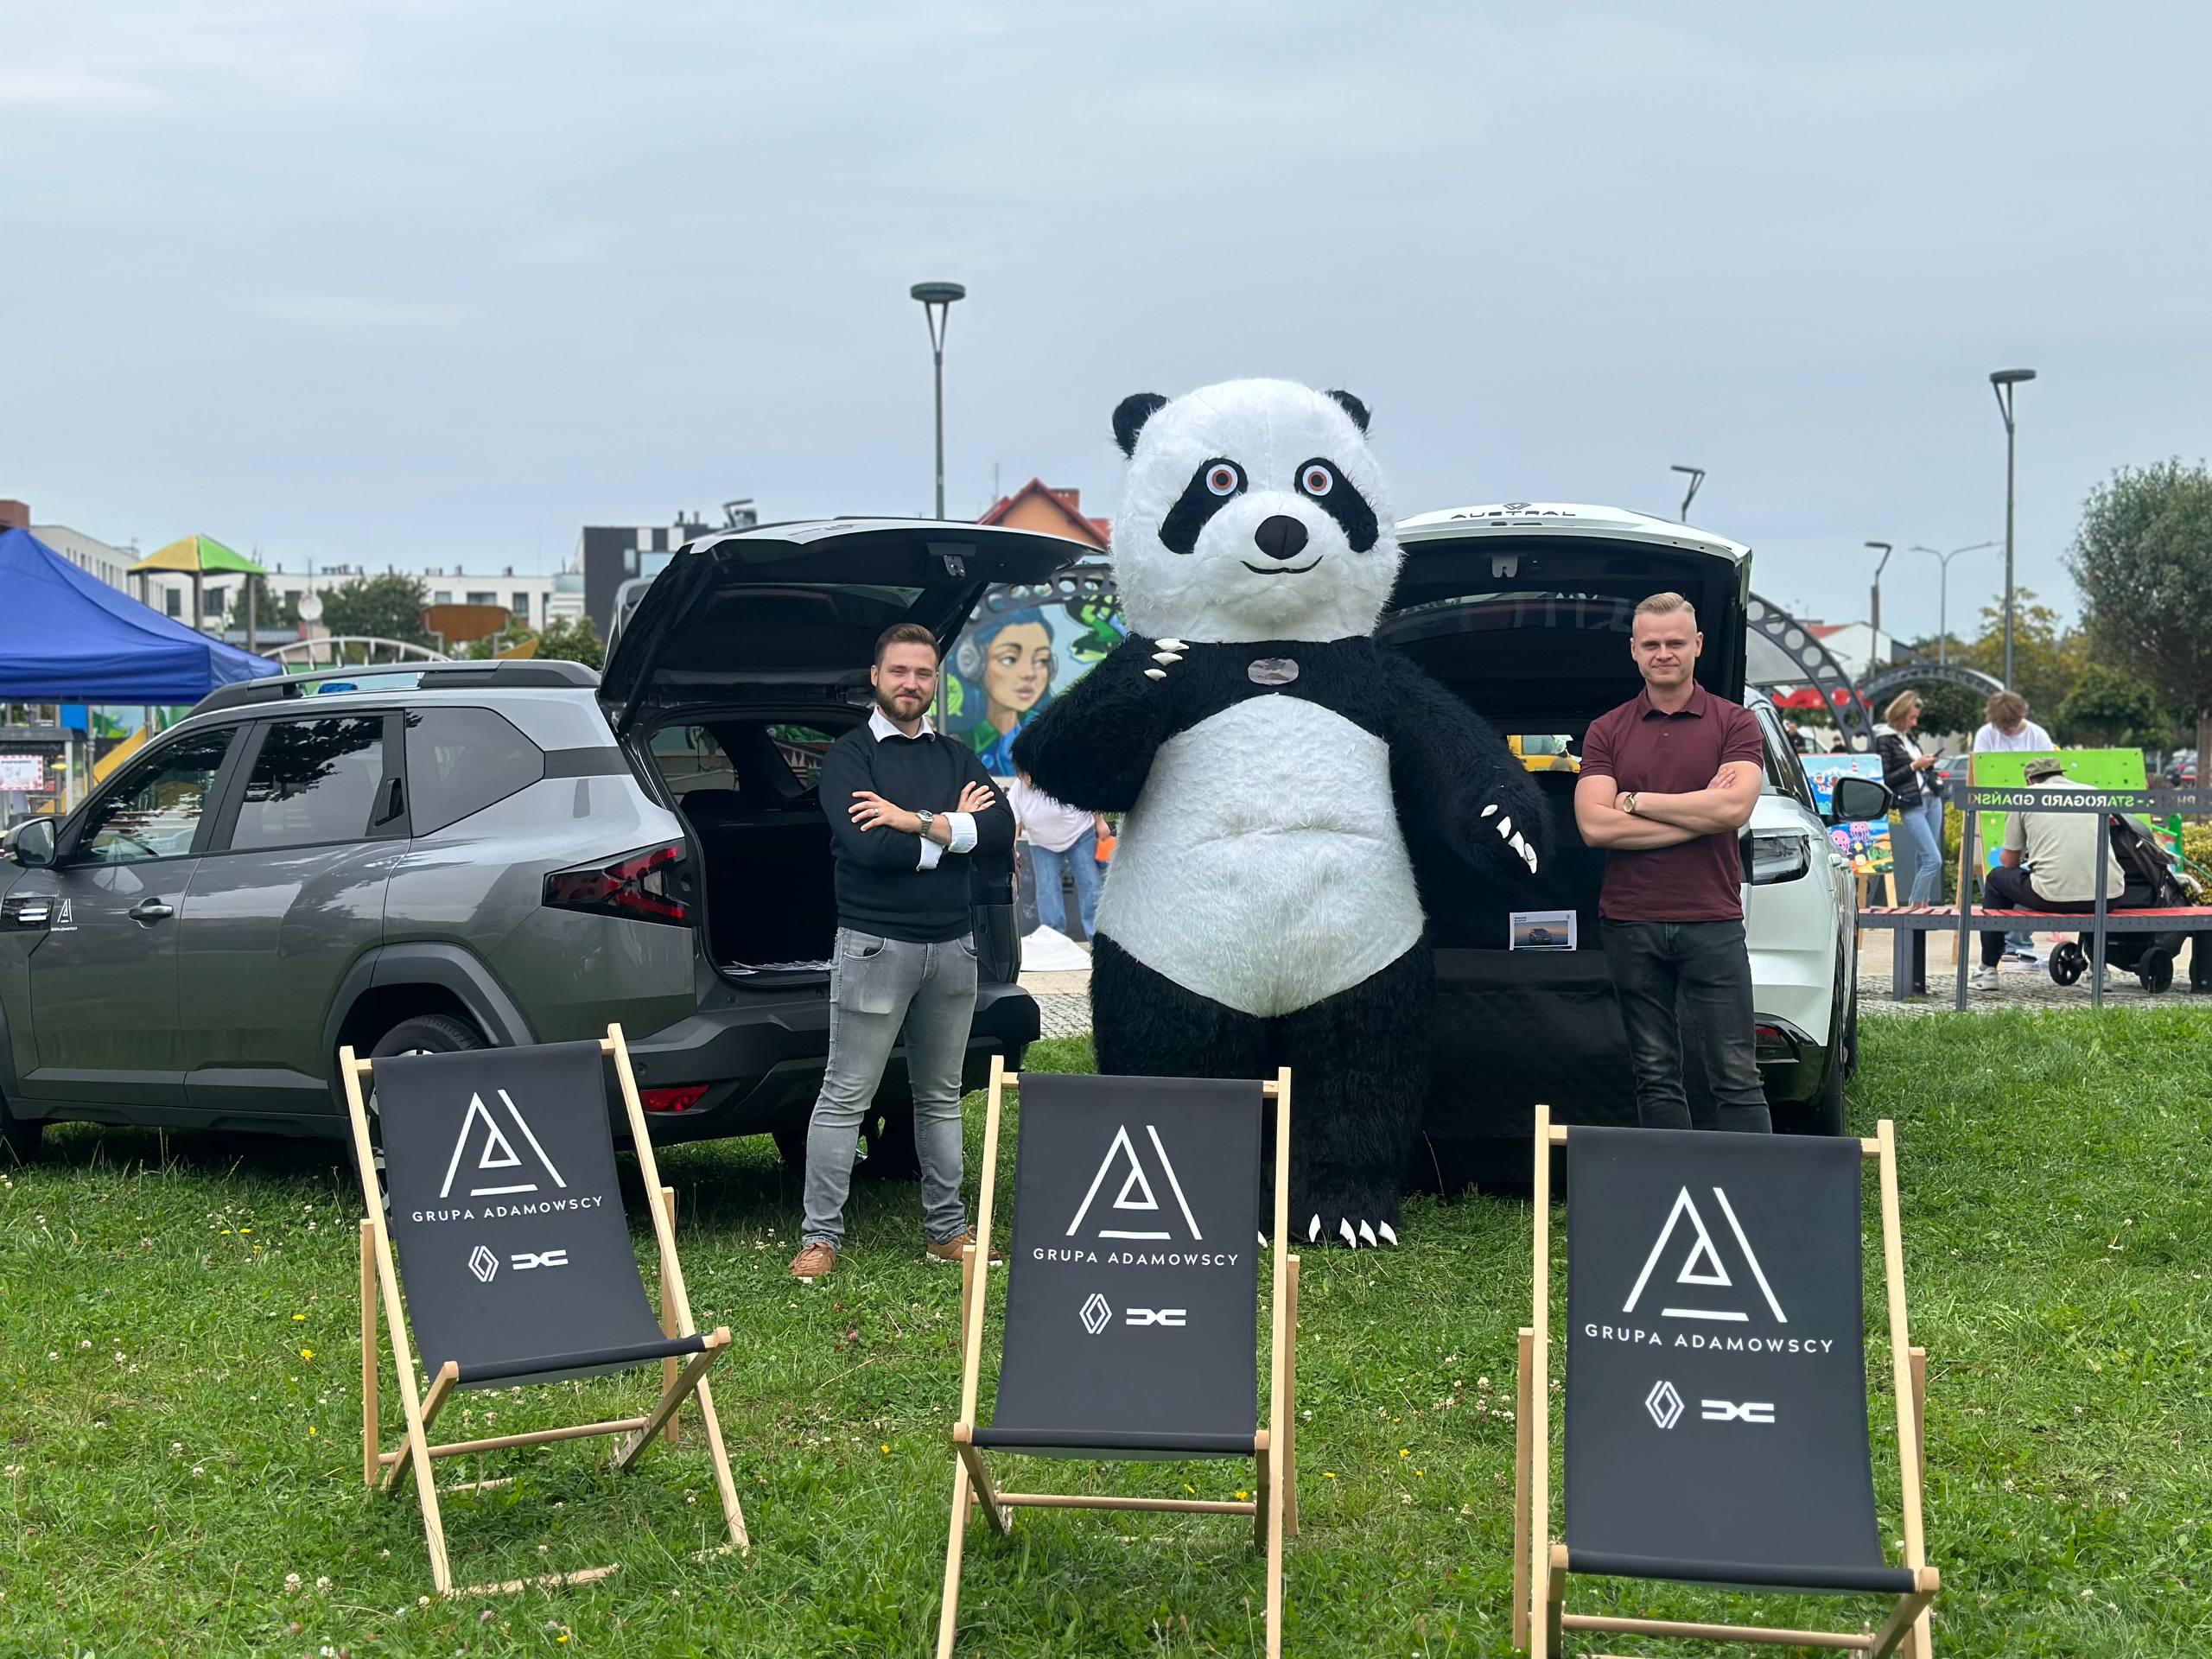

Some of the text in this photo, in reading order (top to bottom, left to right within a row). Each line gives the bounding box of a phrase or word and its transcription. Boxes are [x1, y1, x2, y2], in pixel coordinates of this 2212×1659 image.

[1451, 511, 1576, 519] AUSTRAL
[412, 1196, 602, 1223] GRUPA ADAMOWSCY
[1033, 1248, 1238, 1266] GRUPA ADAMOWSCY
[1585, 1323, 1833, 1353] GRUPA ADAMOWSCY
